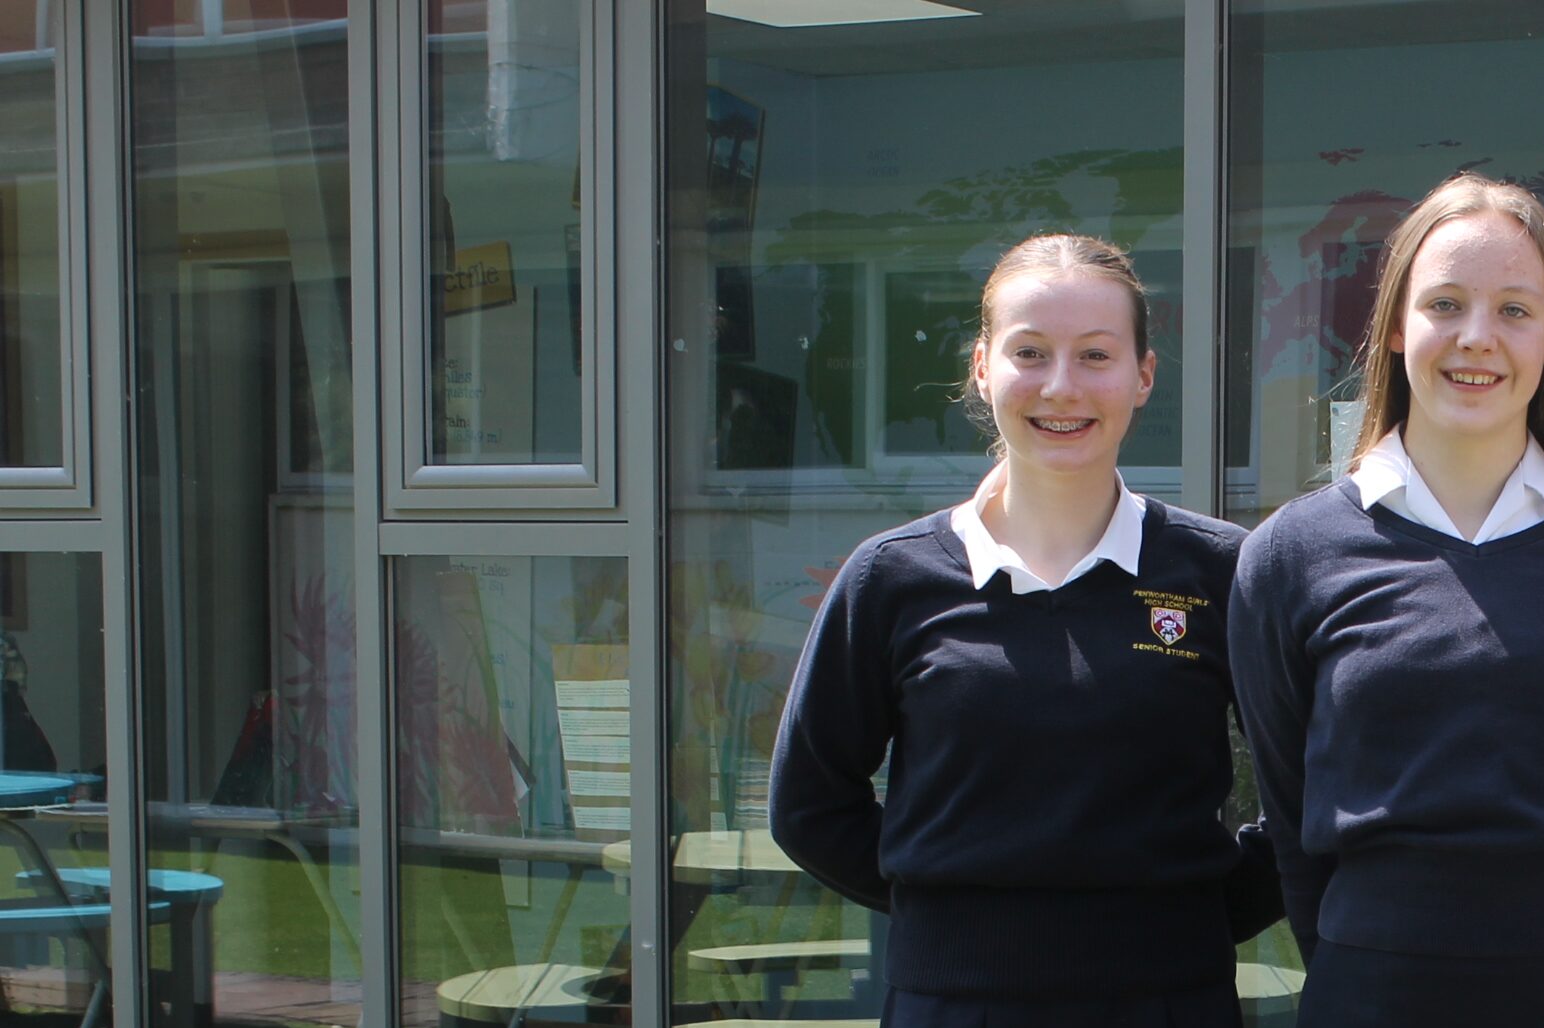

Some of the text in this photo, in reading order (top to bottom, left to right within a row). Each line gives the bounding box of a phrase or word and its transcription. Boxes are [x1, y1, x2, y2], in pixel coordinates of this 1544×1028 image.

[1293, 314, 1320, 328] ALPS
[1132, 589, 1186, 602] PENWORTHAM
[1144, 598, 1194, 612] HIGH SCHOOL
[1132, 643, 1200, 660] SENIOR STUDENT
